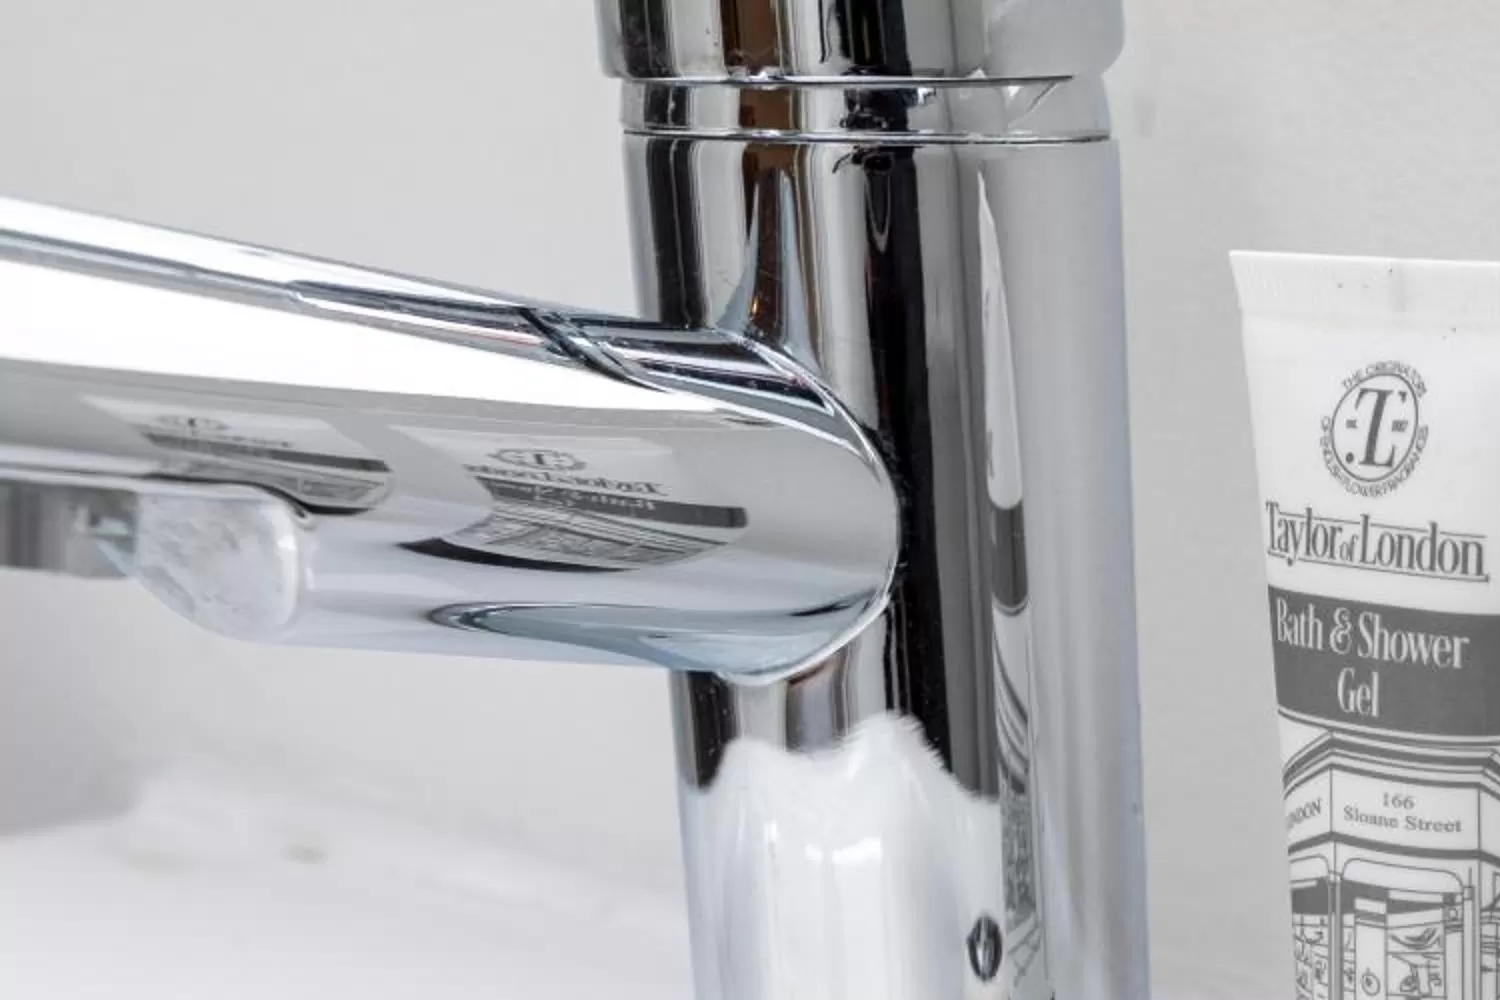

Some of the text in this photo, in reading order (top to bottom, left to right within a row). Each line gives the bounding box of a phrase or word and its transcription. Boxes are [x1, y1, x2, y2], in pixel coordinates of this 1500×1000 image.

[1265, 501, 1486, 577] Taylor of London
[1276, 596, 1470, 668] Bath & Shower
[1337, 667, 1380, 717] Gel
[1343, 805, 1463, 833] Sloane Street
[1382, 792, 1415, 809] 166
